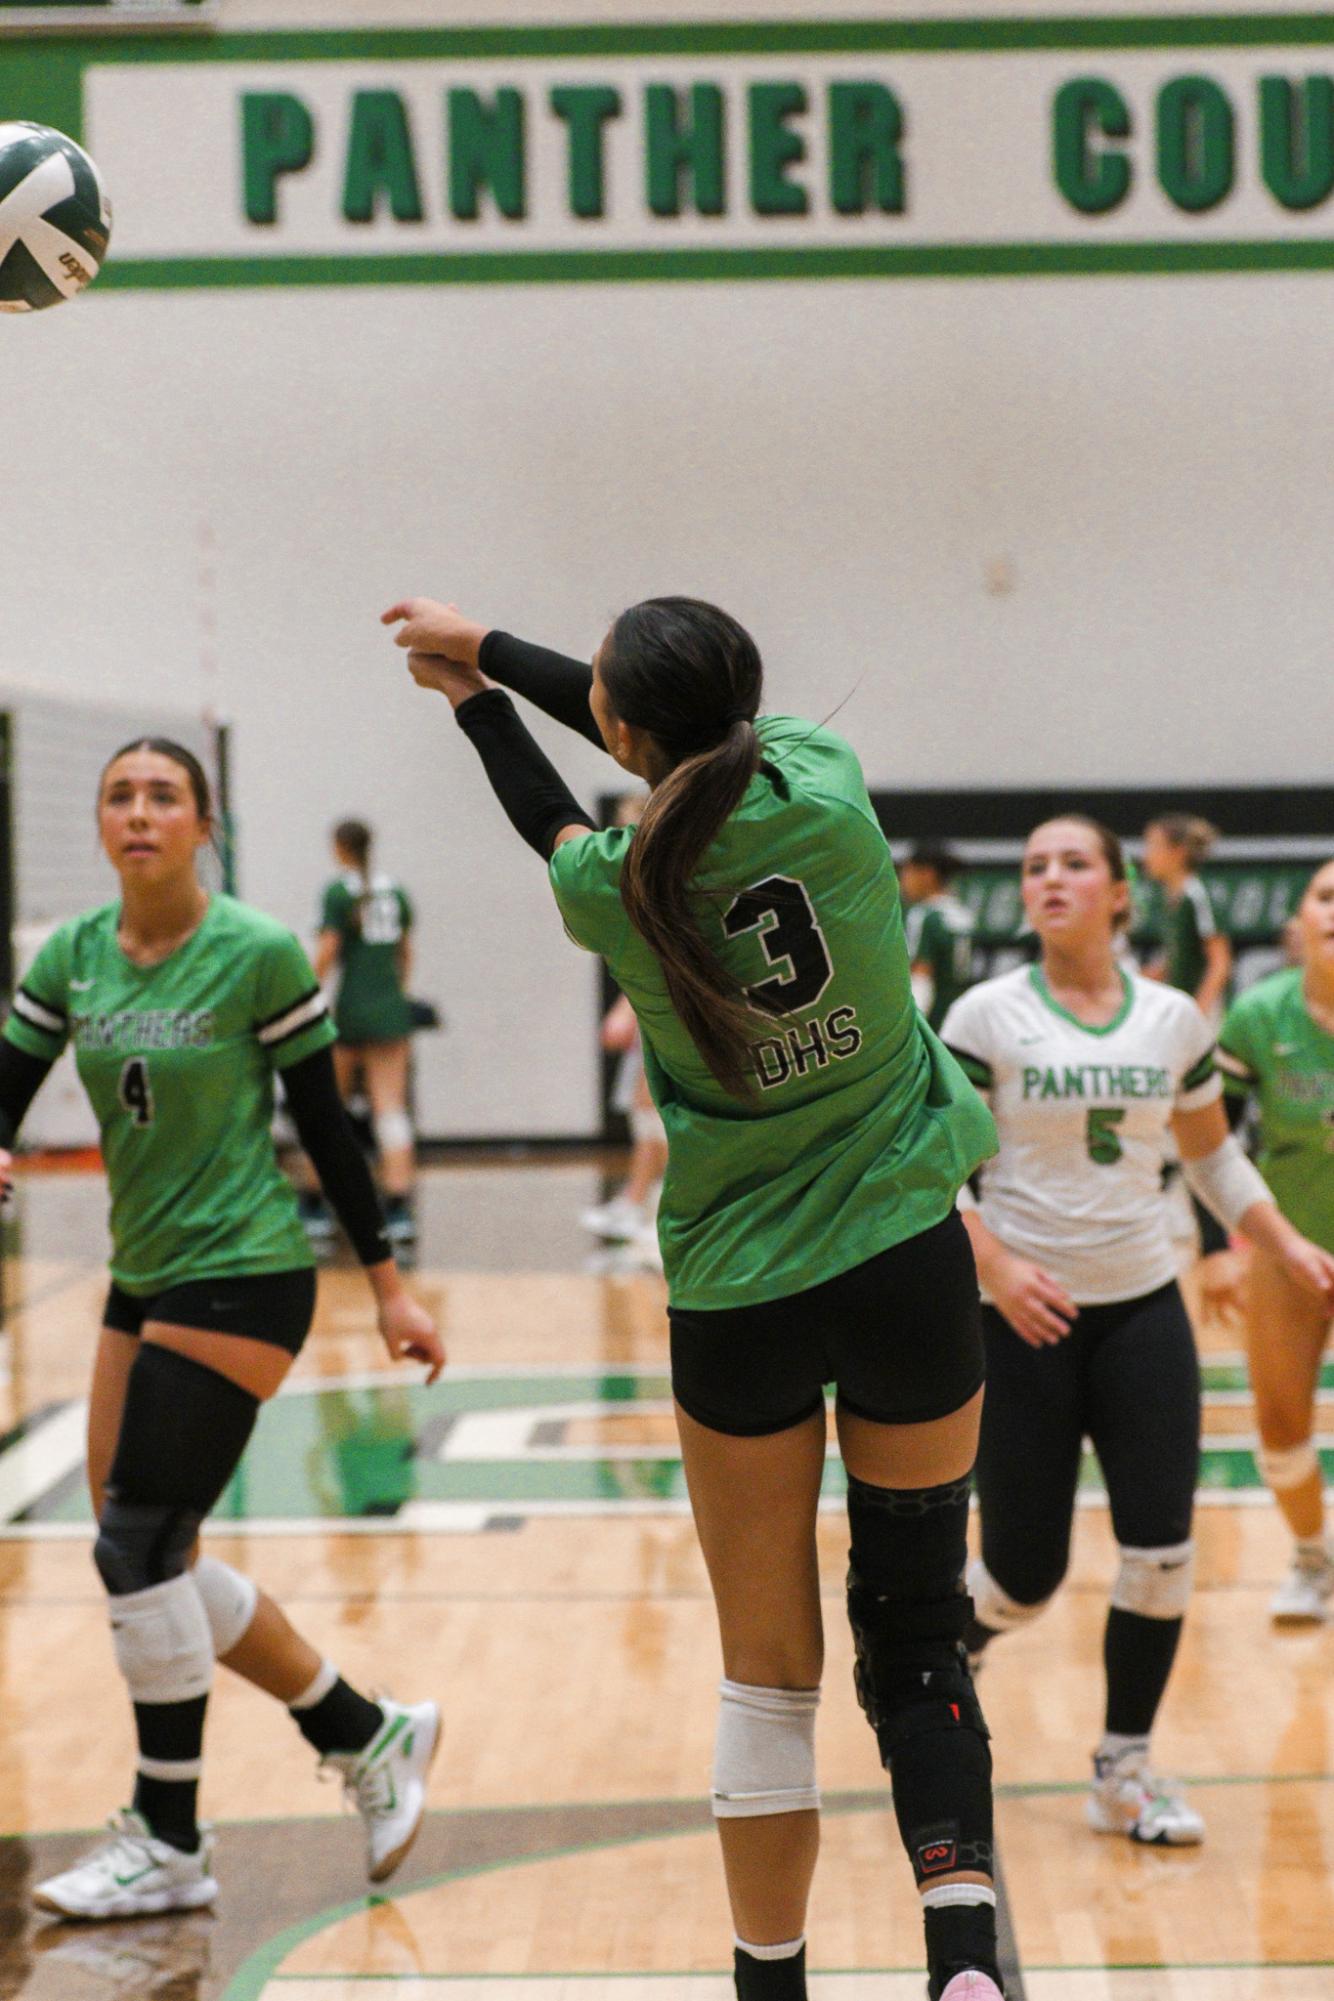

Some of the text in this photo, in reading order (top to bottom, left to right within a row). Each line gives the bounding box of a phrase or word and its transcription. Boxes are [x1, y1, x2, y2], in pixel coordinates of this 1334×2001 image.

[239, 73, 1334, 225] PANTHER COU
[720, 873, 835, 1021] 3
[747, 1004, 863, 1091] DHS
[117, 1055, 155, 1129] 4
[1086, 1107, 1126, 1165] 5
